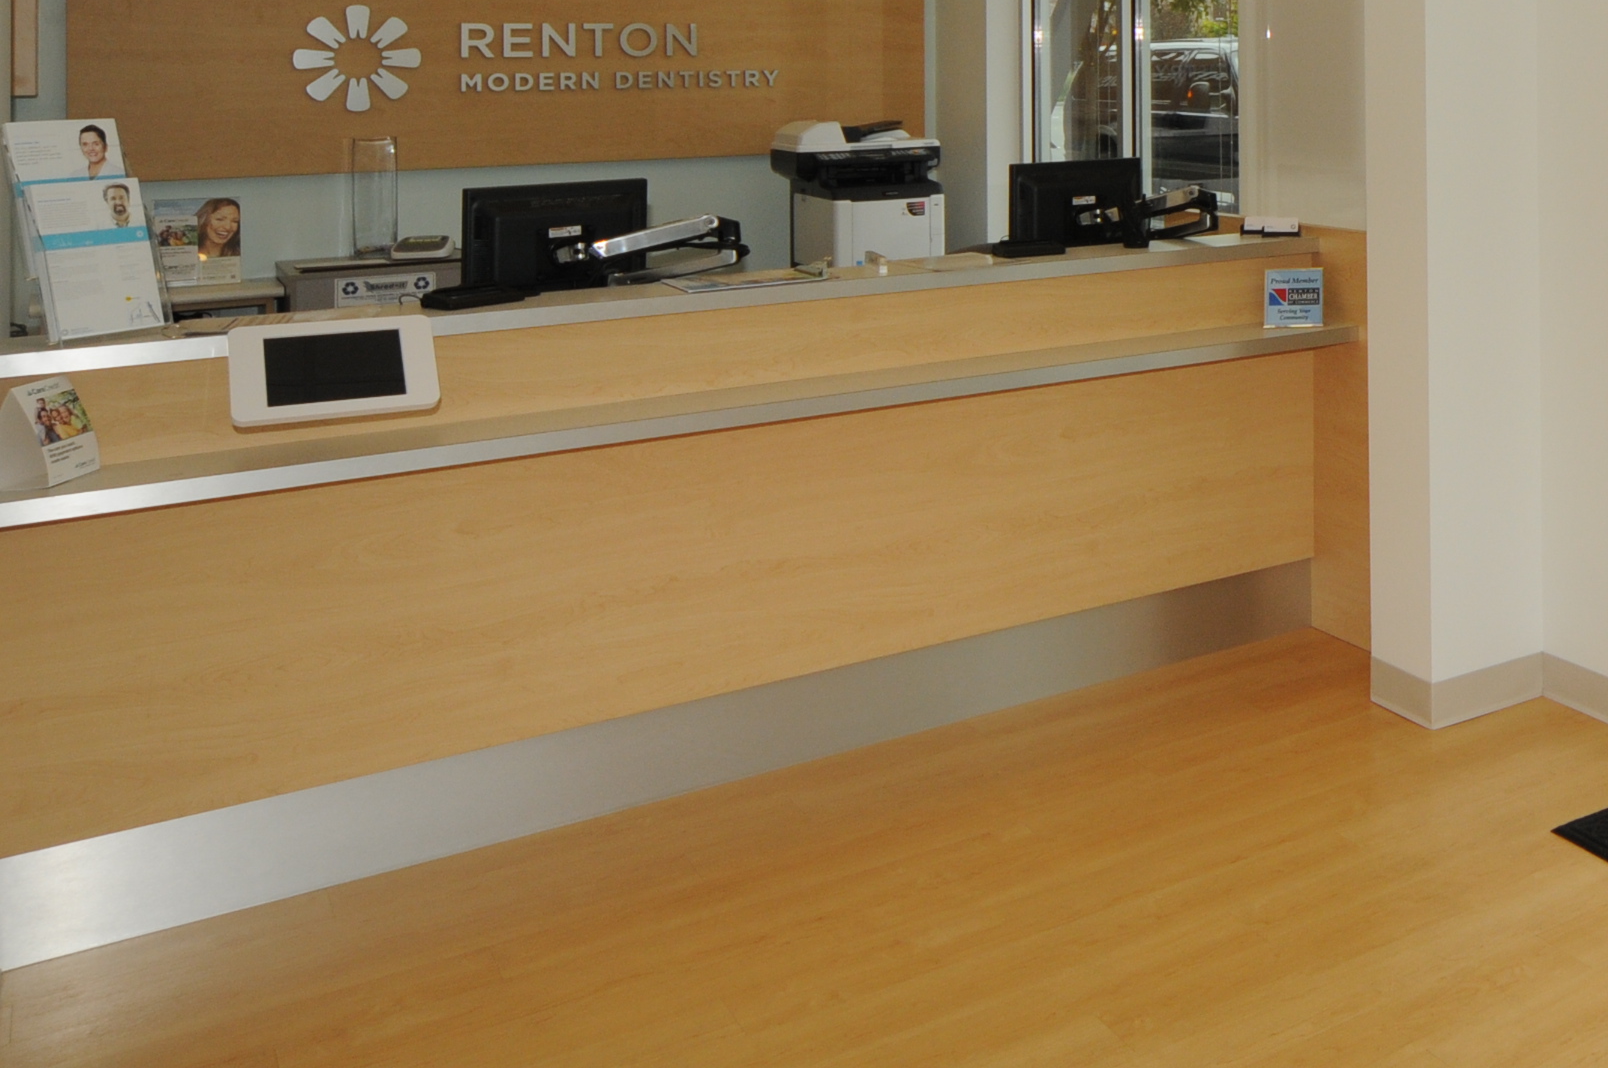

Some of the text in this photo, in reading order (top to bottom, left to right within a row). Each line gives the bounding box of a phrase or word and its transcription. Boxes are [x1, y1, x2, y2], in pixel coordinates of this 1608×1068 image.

[460, 22, 698, 58] RENTON
[460, 69, 779, 92] MODERN DENTISTRY
[1292, 276, 1319, 284] Member
